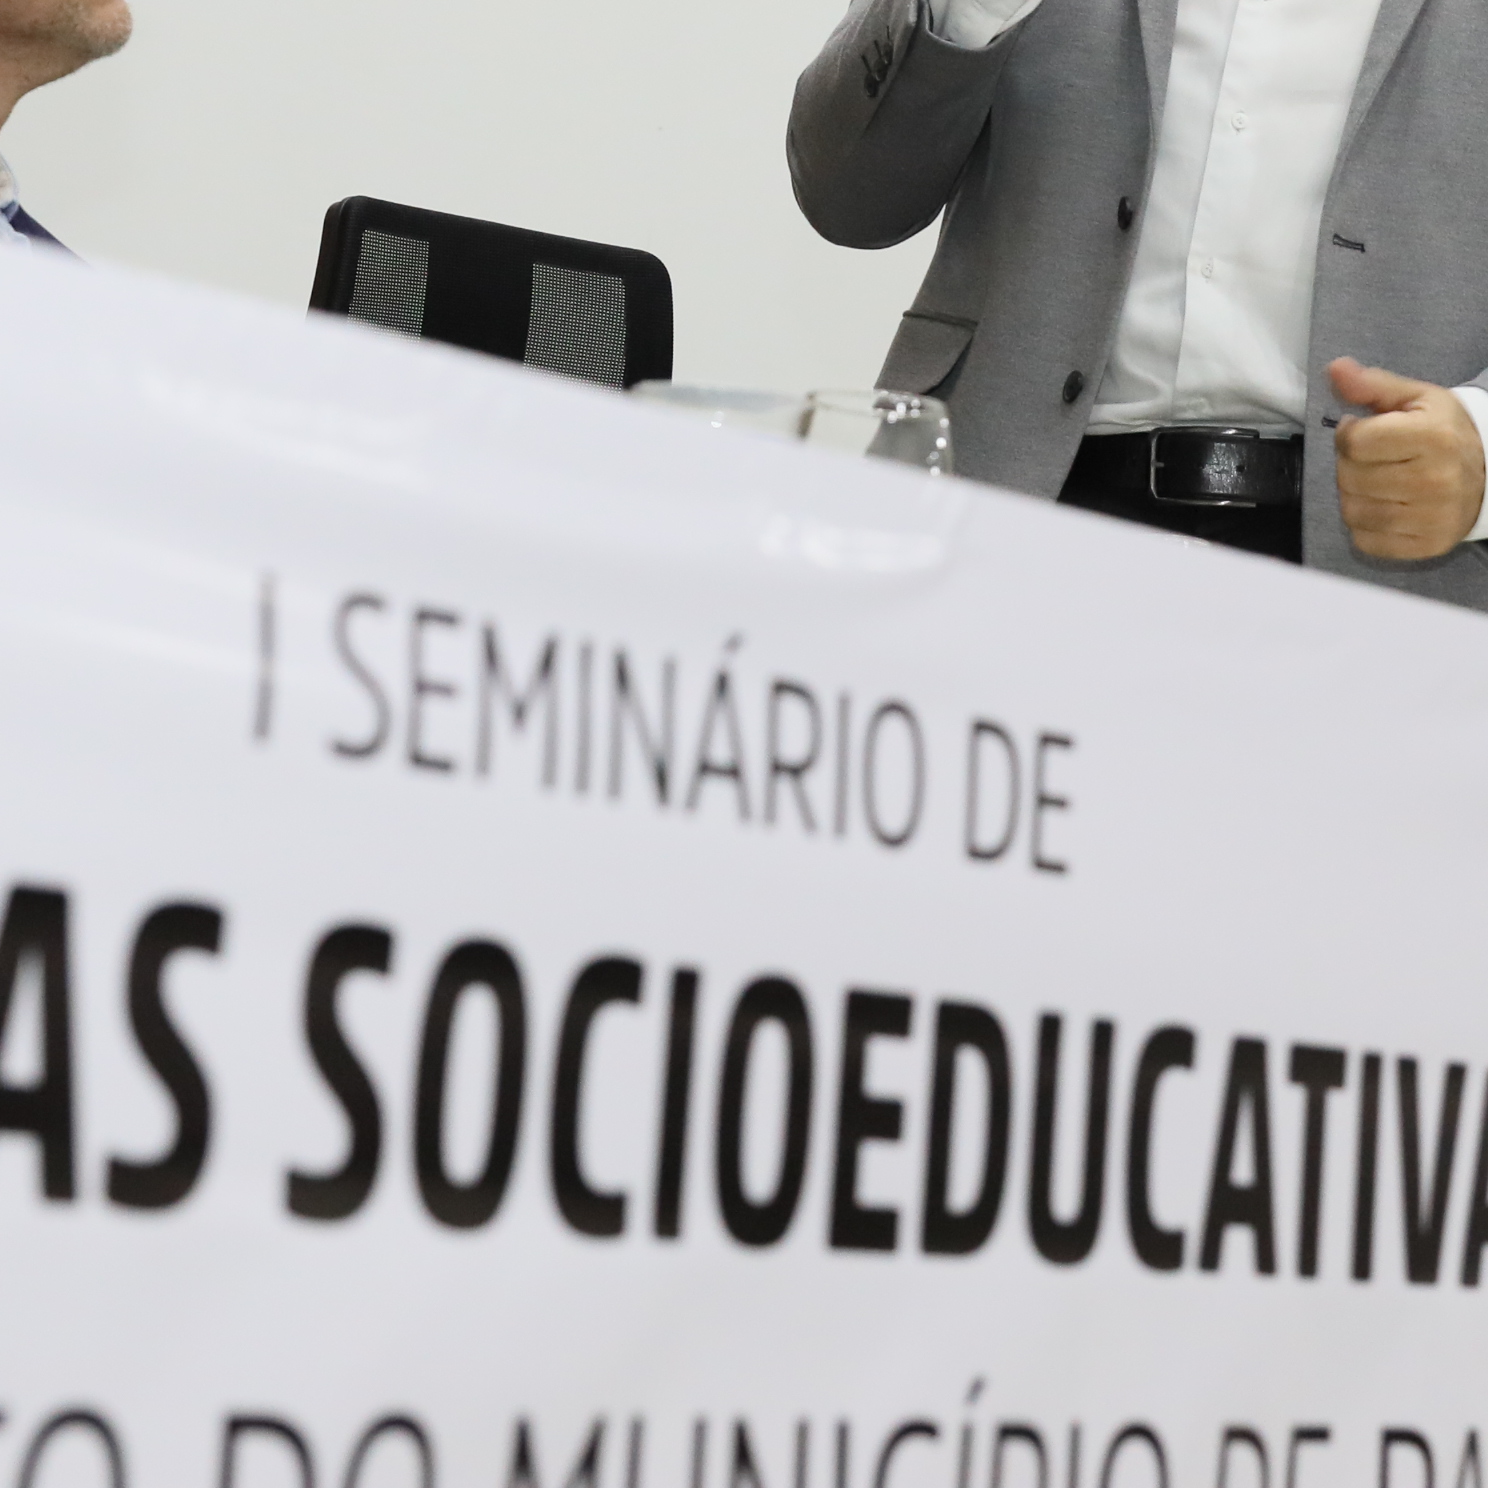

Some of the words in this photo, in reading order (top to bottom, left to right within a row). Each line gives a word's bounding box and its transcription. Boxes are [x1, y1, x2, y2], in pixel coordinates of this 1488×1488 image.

[251, 574, 276, 742] I
[328, 590, 926, 852] SEMINÁRIO
[963, 716, 1076, 877] DE
